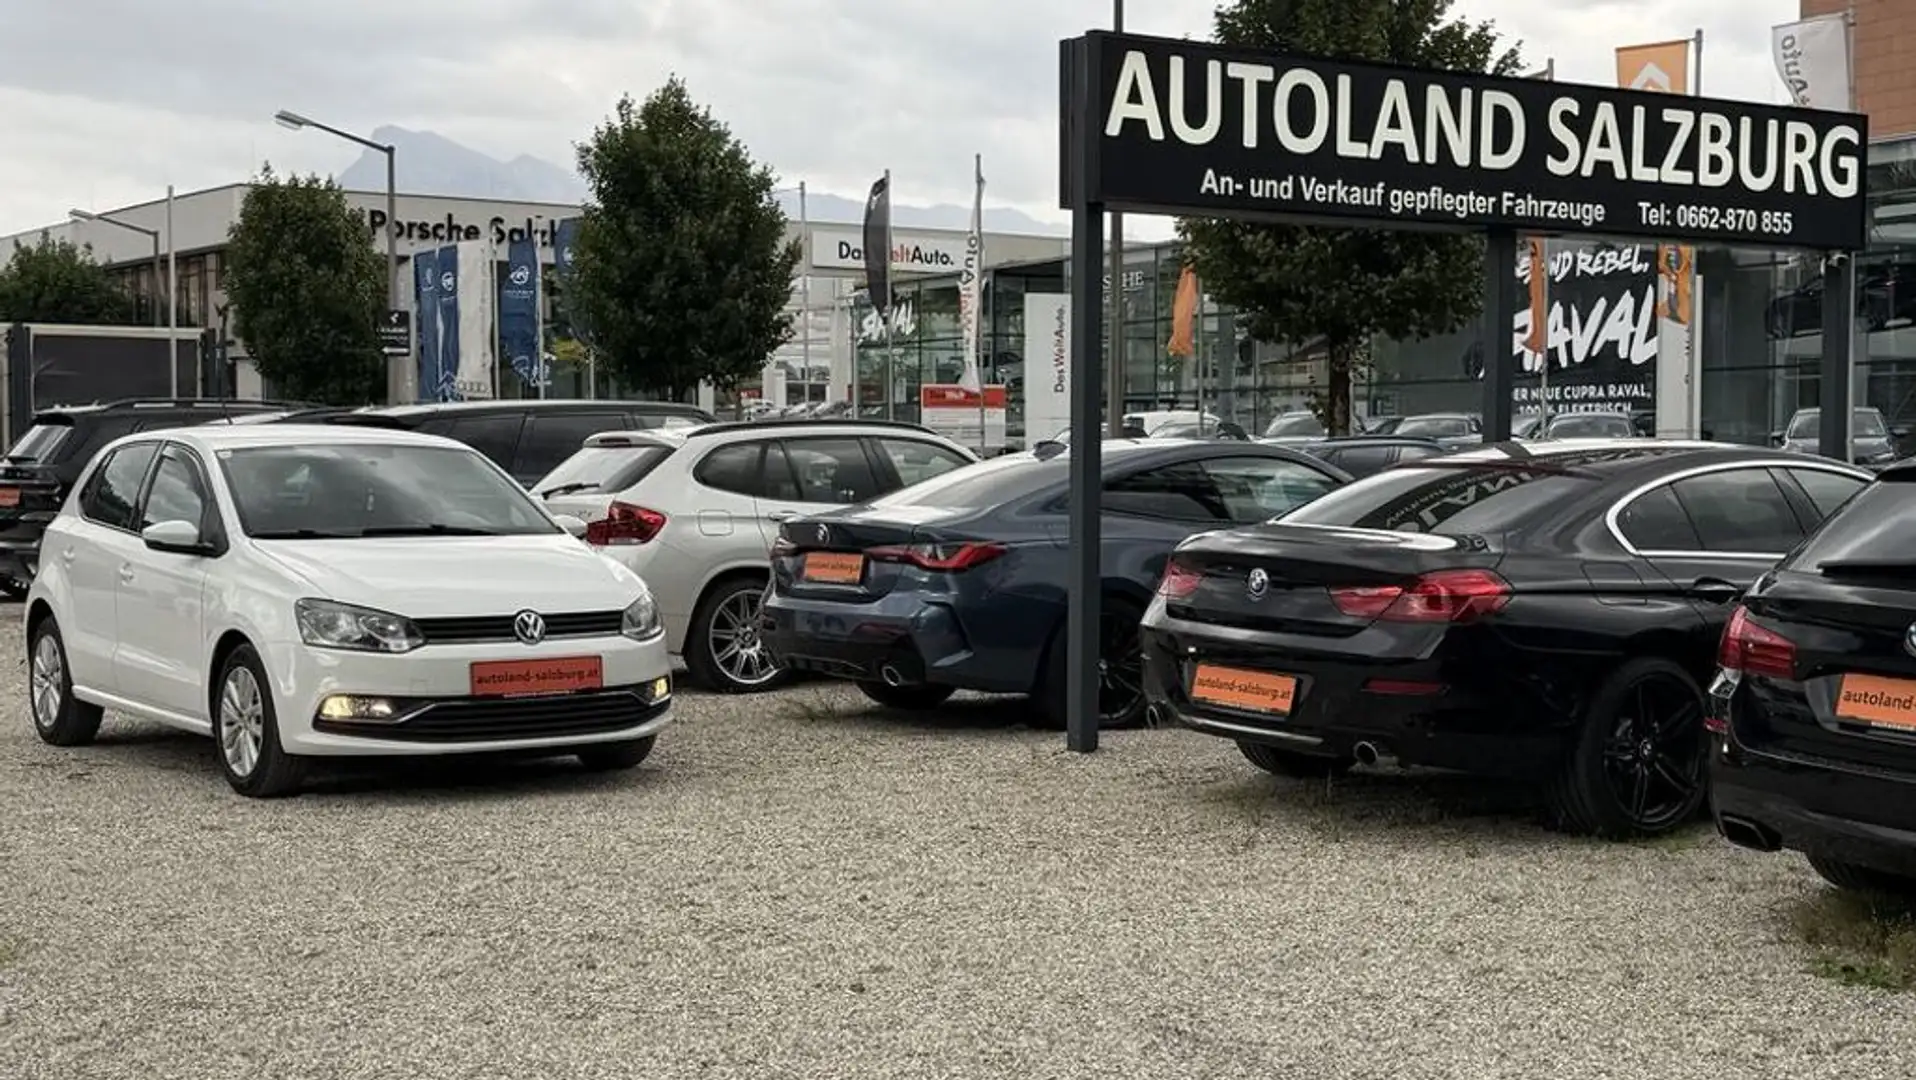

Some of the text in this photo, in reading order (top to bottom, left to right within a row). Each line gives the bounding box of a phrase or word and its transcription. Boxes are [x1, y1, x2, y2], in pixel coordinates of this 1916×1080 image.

[1104, 50, 1860, 198] AUTOLAND SALZBURG
[1201, 169, 1792, 233] An- und Verkauf gepflegter Fahrzeuge Tel: 0662-870 855
[1563, 385, 1605, 399] CUPRA
[476, 667, 599, 685] autoland-salzburg.at
